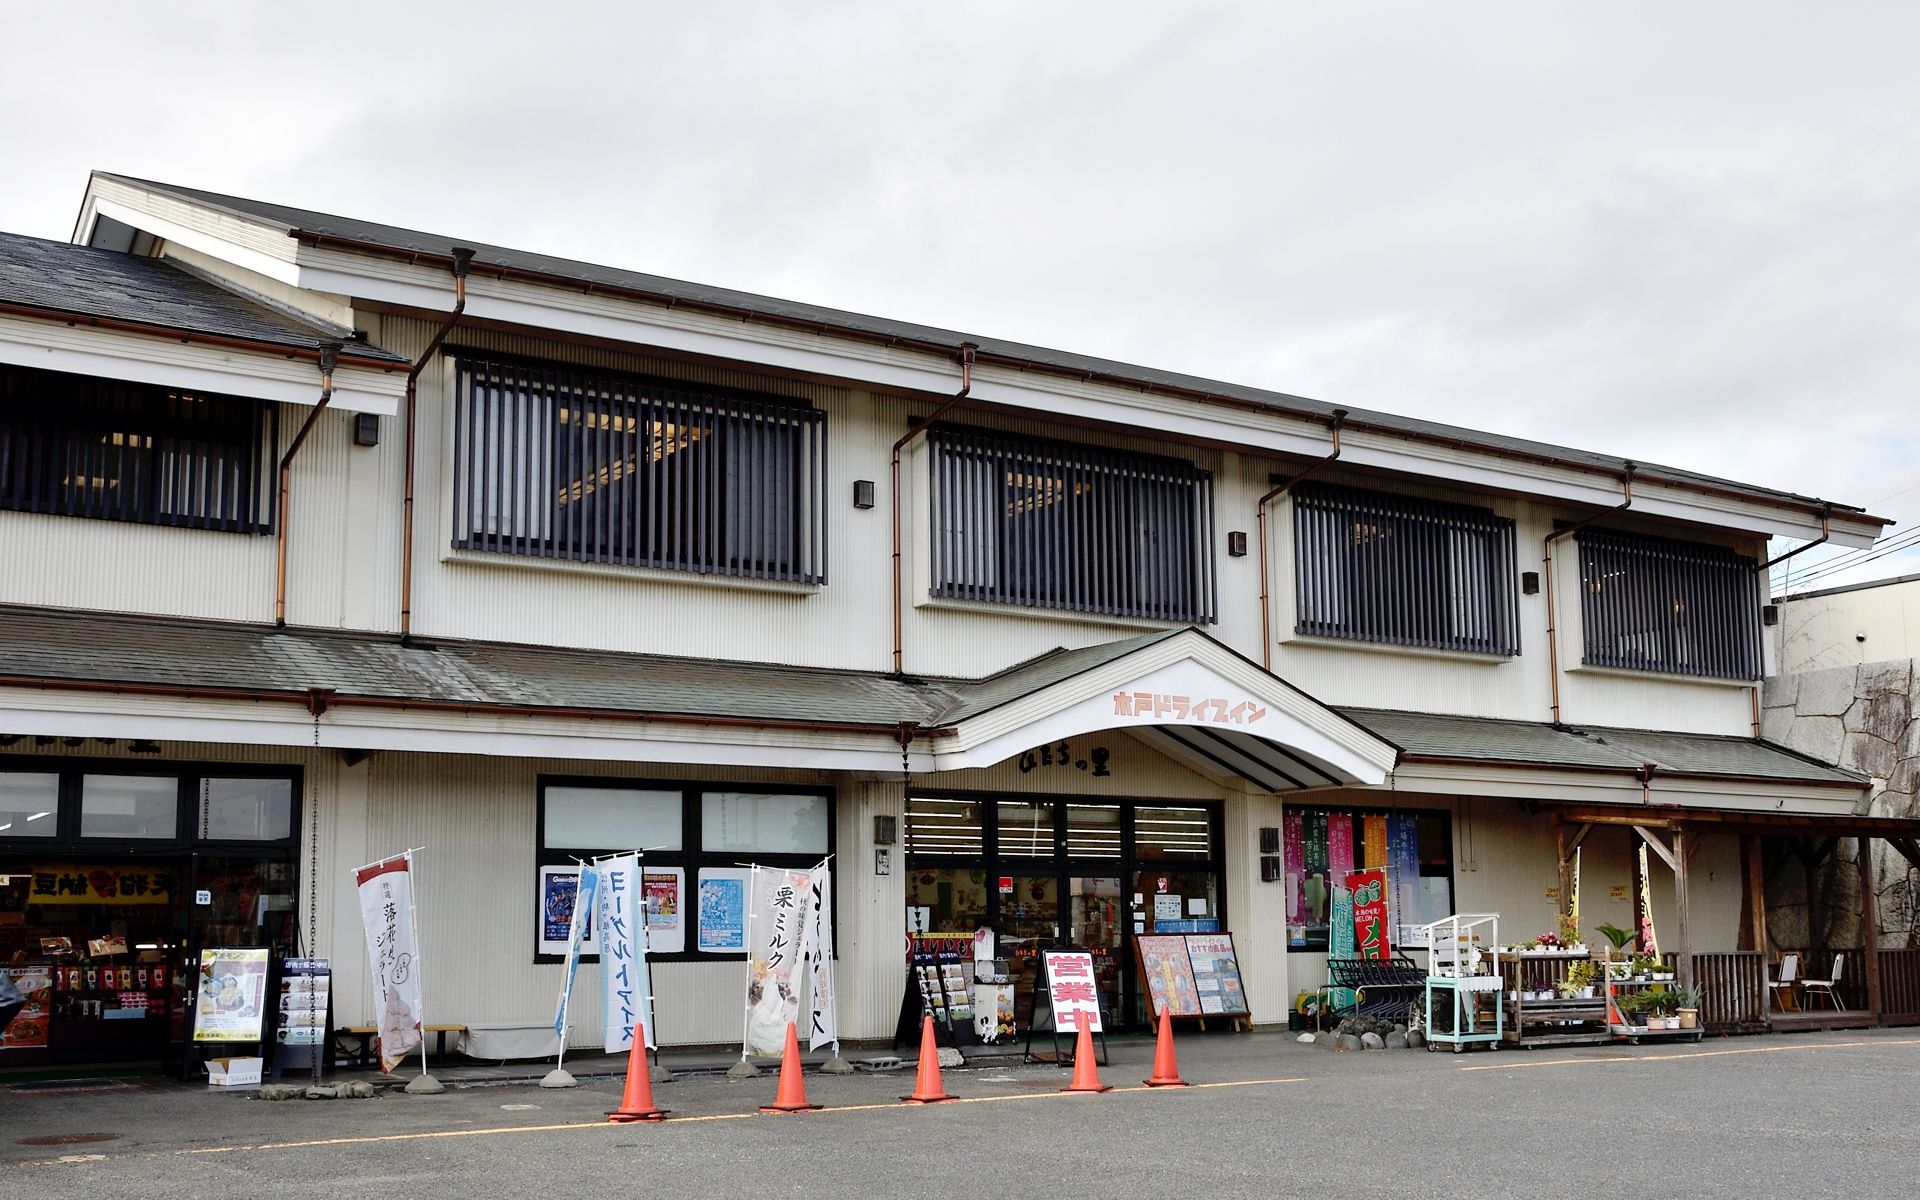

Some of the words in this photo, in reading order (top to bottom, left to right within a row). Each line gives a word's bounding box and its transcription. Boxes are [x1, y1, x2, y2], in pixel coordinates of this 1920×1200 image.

[383, 902, 397, 966] 落花生
[769, 886, 794, 970] 栗ミルク
[794, 897, 807, 965] 秋の味覚ジェラート
[376, 931, 389, 1002] ジェラート
[1047, 955, 1099, 1032] 営業中
